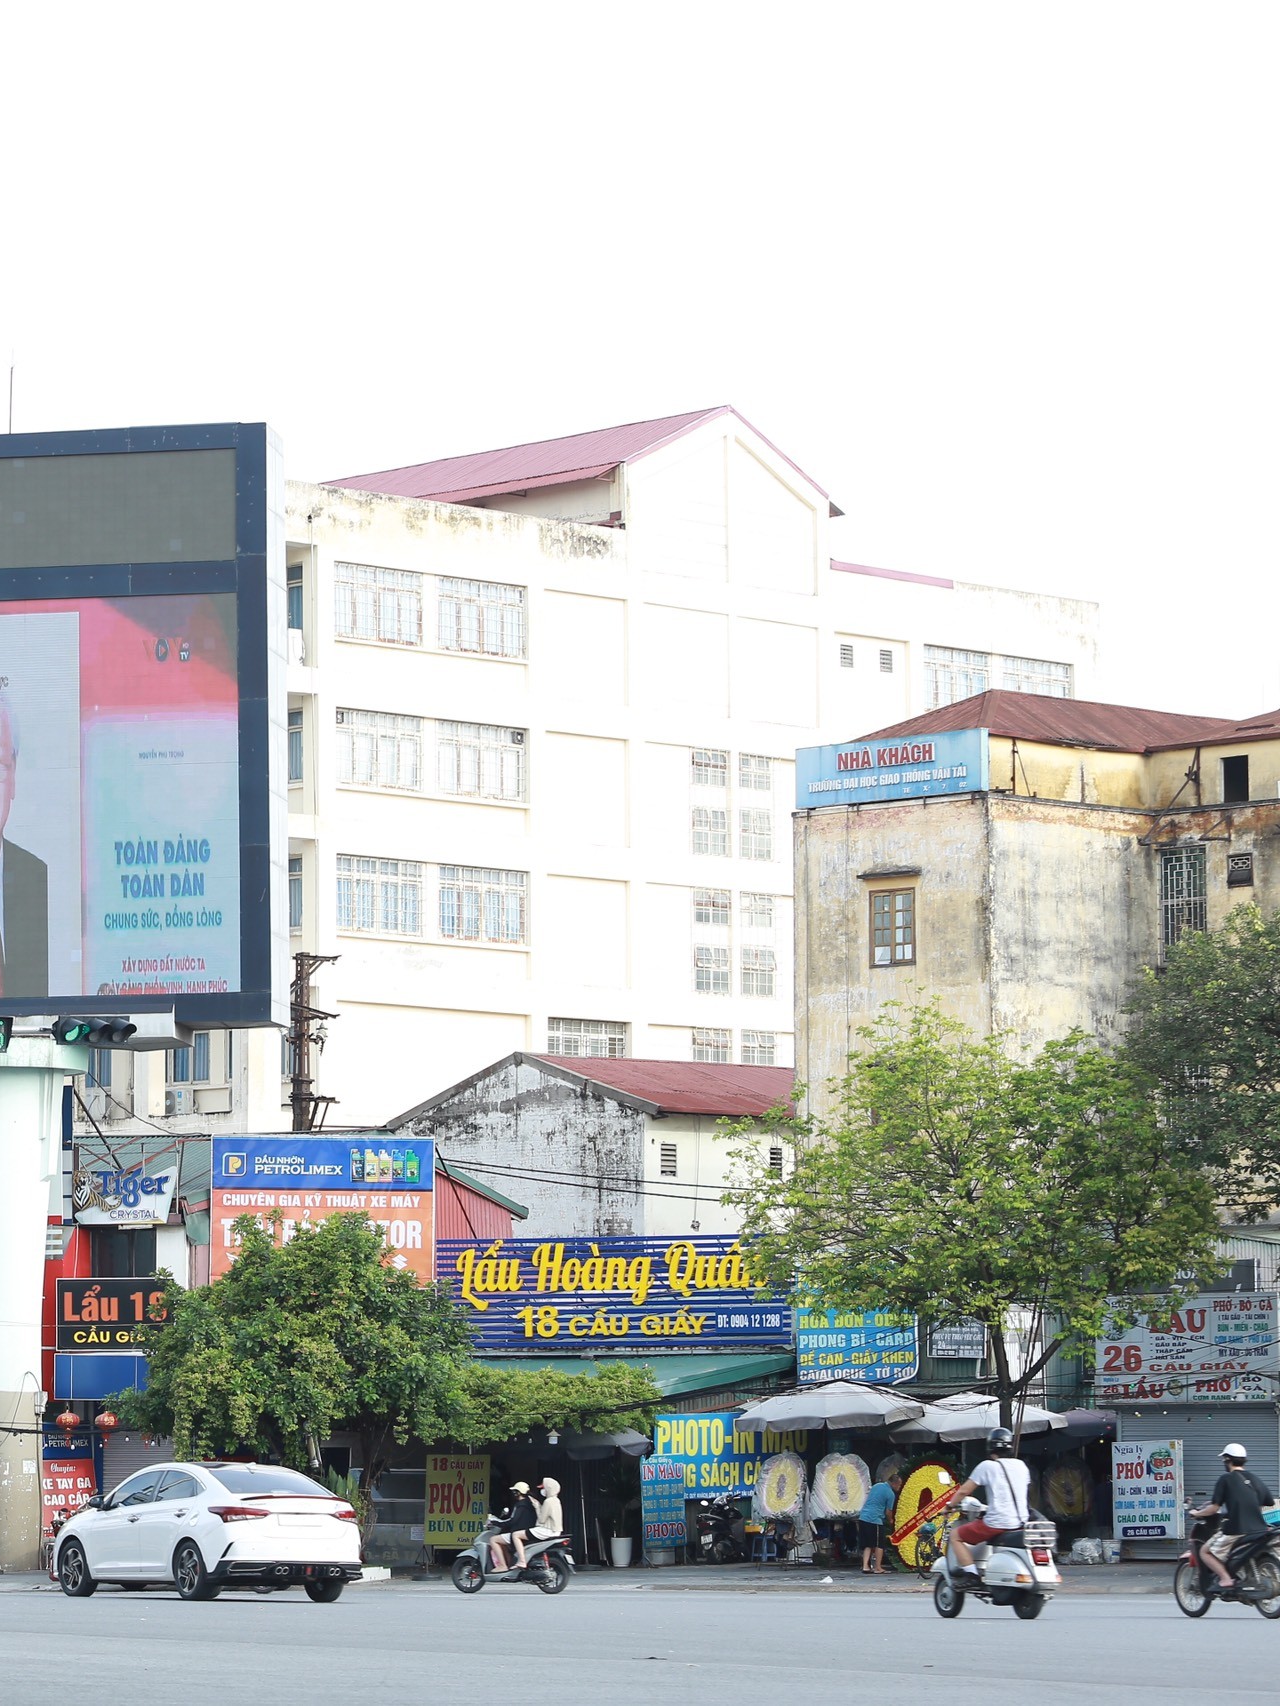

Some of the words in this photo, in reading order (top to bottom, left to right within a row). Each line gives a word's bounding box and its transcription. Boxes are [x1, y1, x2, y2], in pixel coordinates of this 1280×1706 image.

[837, 746, 873, 771] NHÀ
[877, 742, 935, 767] KHÁCH
[860, 775, 877, 790] HỌC
[879, 773, 900, 786] GIAO
[115, 836, 158, 865] TOÀN
[121, 870, 165, 898] TOÀN
[170, 869, 205, 896] DÂN
[104, 912, 138, 929] CHUNG
[197, 958, 205, 970] TA
[254, 1164, 343, 1176] PETROLIMEX
[97, 1168, 170, 1208] Tiger
[222, 1191, 275, 1207] CHUYÊN
[277, 1193, 301, 1207] GIA
[304, 1190, 322, 1207] KỸ
[325, 1190, 367, 1209] THUẬT
[370, 1194, 388, 1207] XE
[391, 1190, 421, 1208] MÁY
[109, 1209, 158, 1220] CRYSTAL
[456, 1239, 524, 1311] Lẩu
[532, 1242, 655, 1306] Hoàng
[63, 1285, 118, 1322] Lẩu
[516, 1305, 560, 1338] 18
[569, 1308, 629, 1337] CẦU
[640, 1305, 707, 1335] GIẤY
[731, 1315, 749, 1328] 0904
[751, 1315, 760, 1328] 12
[762, 1313, 781, 1328] 1288
[799, 1333, 847, 1349] PHONG
[851, 1330, 866, 1348] BÌ
[876, 1332, 915, 1347] CARD
[819, 1351, 844, 1366] CAN
[851, 1348, 879, 1365] GIẤY
[882, 1351, 915, 1365] KHEN
[1103, 1345, 1143, 1372] 26
[799, 1367, 866, 1381] CATALOGUE
[875, 1364, 891, 1379] TỜ
[1103, 1386, 1119, 1394] 26
[431, 1457, 448, 1471] 18
[642, 1465, 655, 1481] IN
[700, 1458, 740, 1488] SÁCH
[1116, 1455, 1145, 1480] PHỞ
[55, 1477, 74, 1490] TAY
[76, 1477, 92, 1489] GA
[428, 1470, 466, 1515] PHỞ
[472, 1478, 485, 1495] BÒ
[44, 1494, 66, 1507] CAO
[471, 1499, 484, 1515] GÀ
[428, 1517, 454, 1533] BÚN
[645, 1522, 686, 1540] PHOTO
